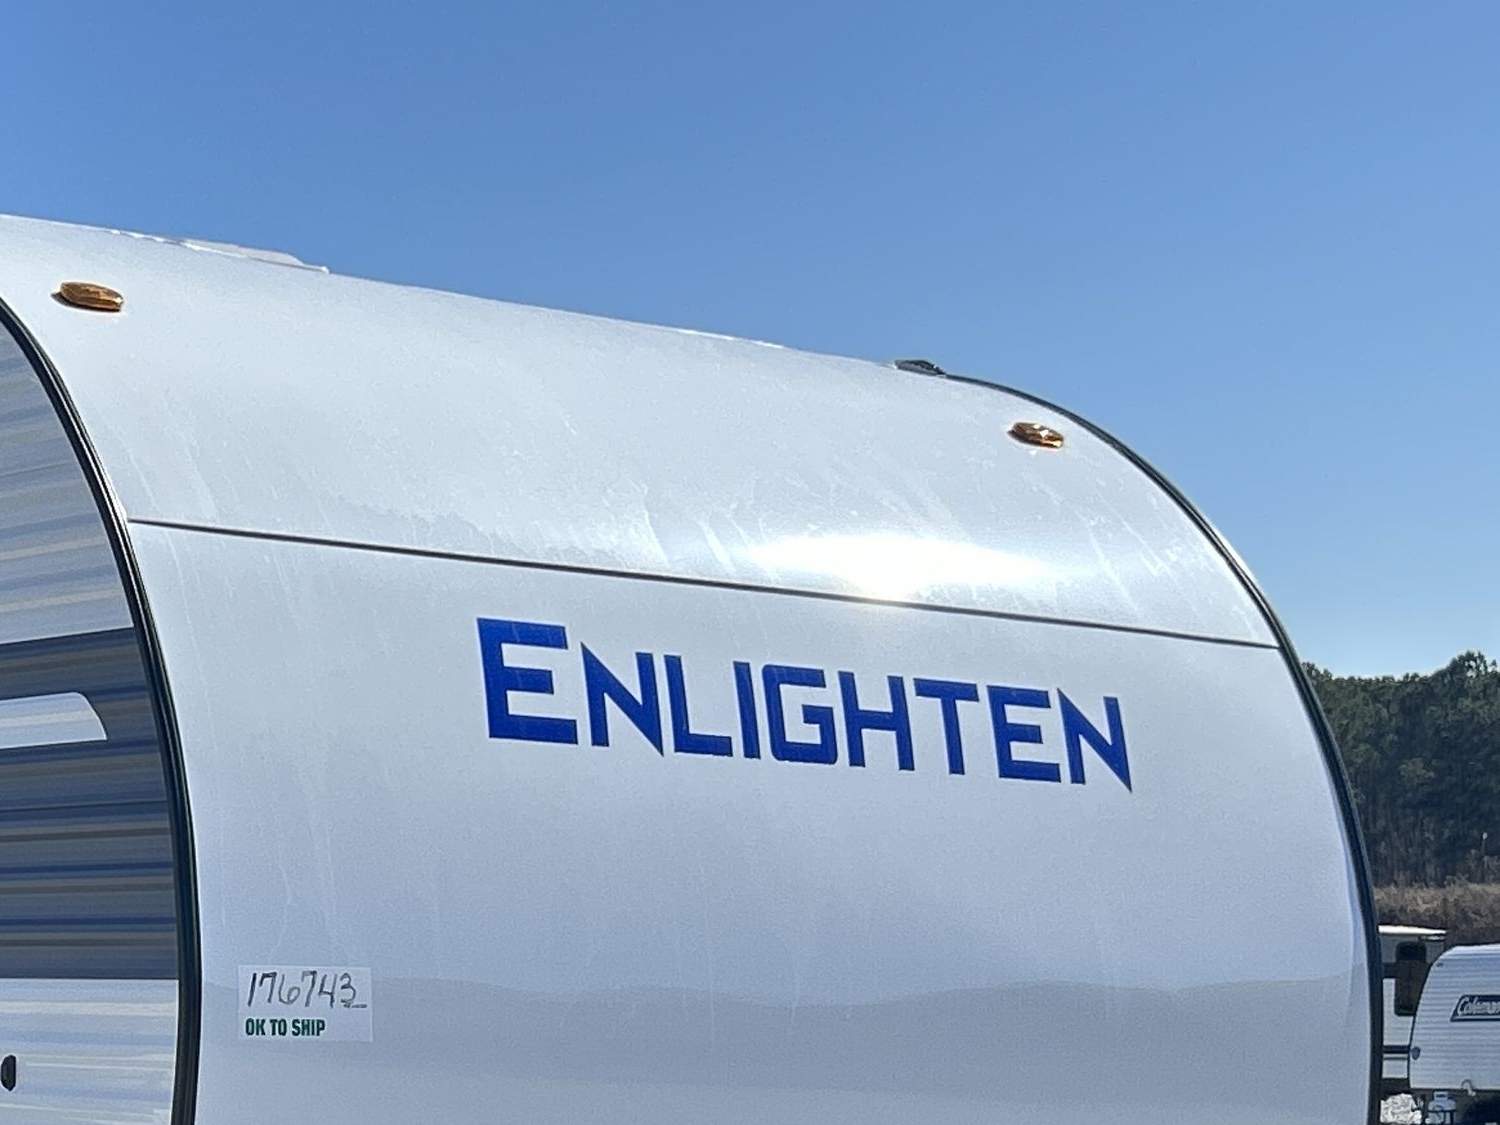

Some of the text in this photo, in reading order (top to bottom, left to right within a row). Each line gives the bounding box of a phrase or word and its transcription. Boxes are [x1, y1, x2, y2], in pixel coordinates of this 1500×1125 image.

[245, 1018, 326, 1036] OK TO SHIP
